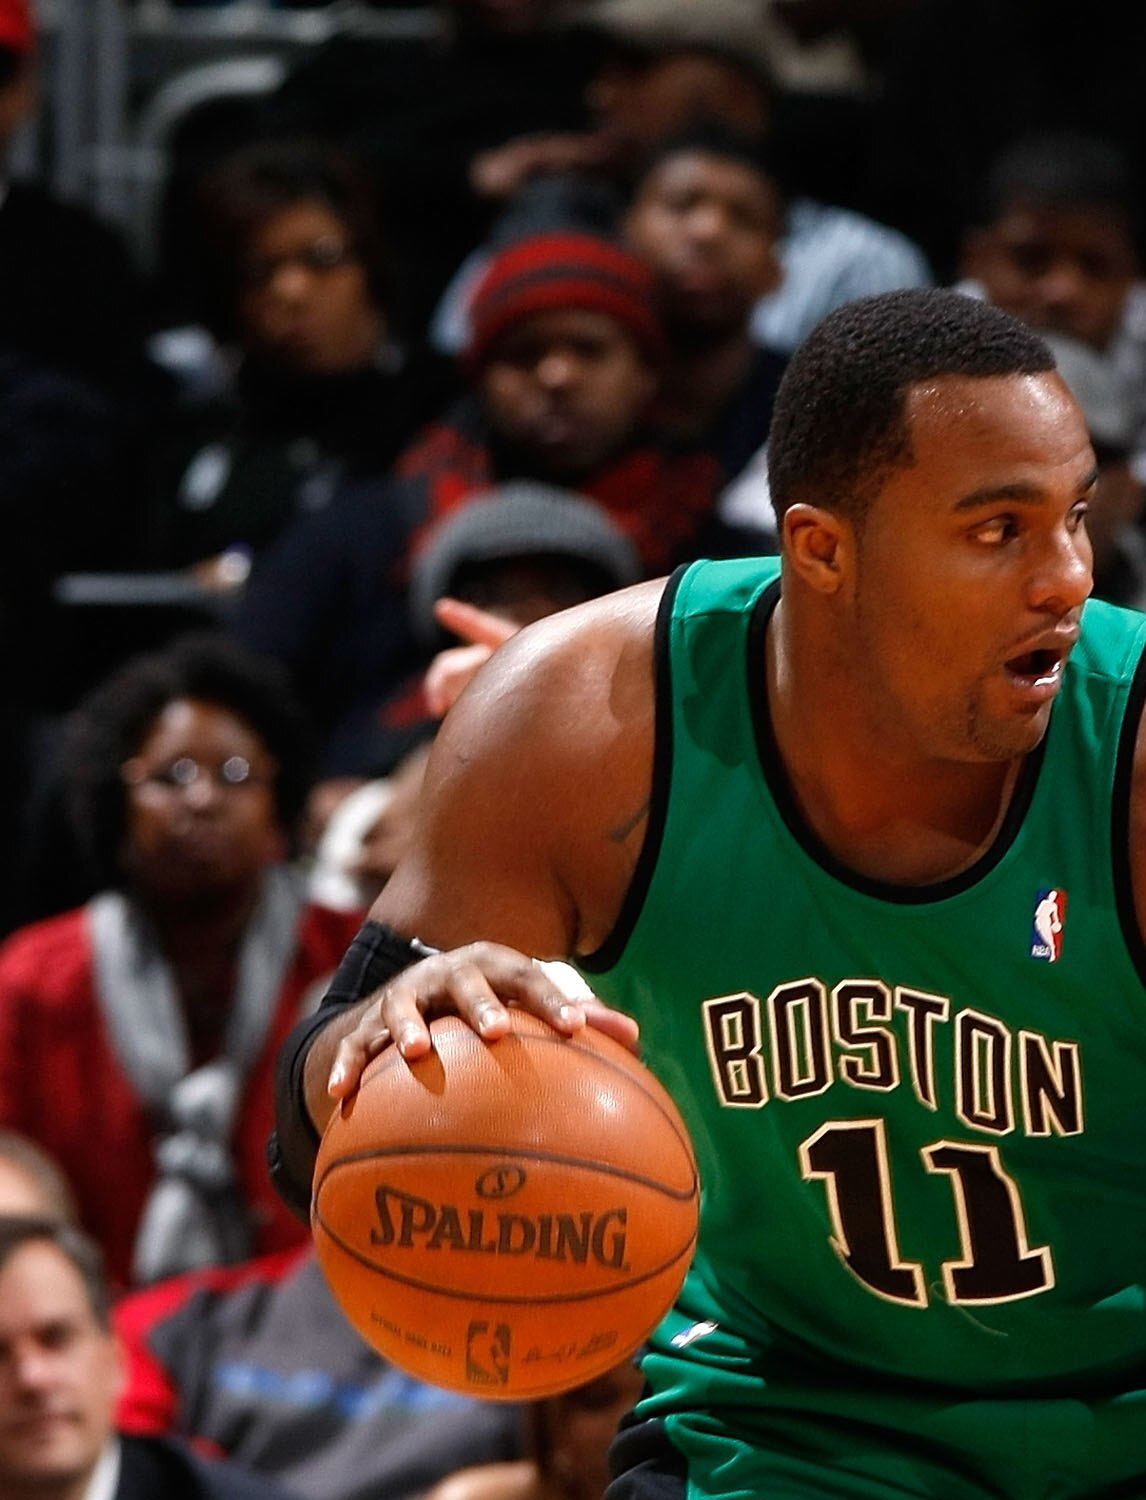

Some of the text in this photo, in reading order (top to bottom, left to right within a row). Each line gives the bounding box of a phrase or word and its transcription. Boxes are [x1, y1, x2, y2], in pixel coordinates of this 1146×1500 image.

[702, 976, 1085, 1138] BOSTON
[370, 1184, 628, 1271] SPALDING
[798, 1117, 1056, 1309] 11
